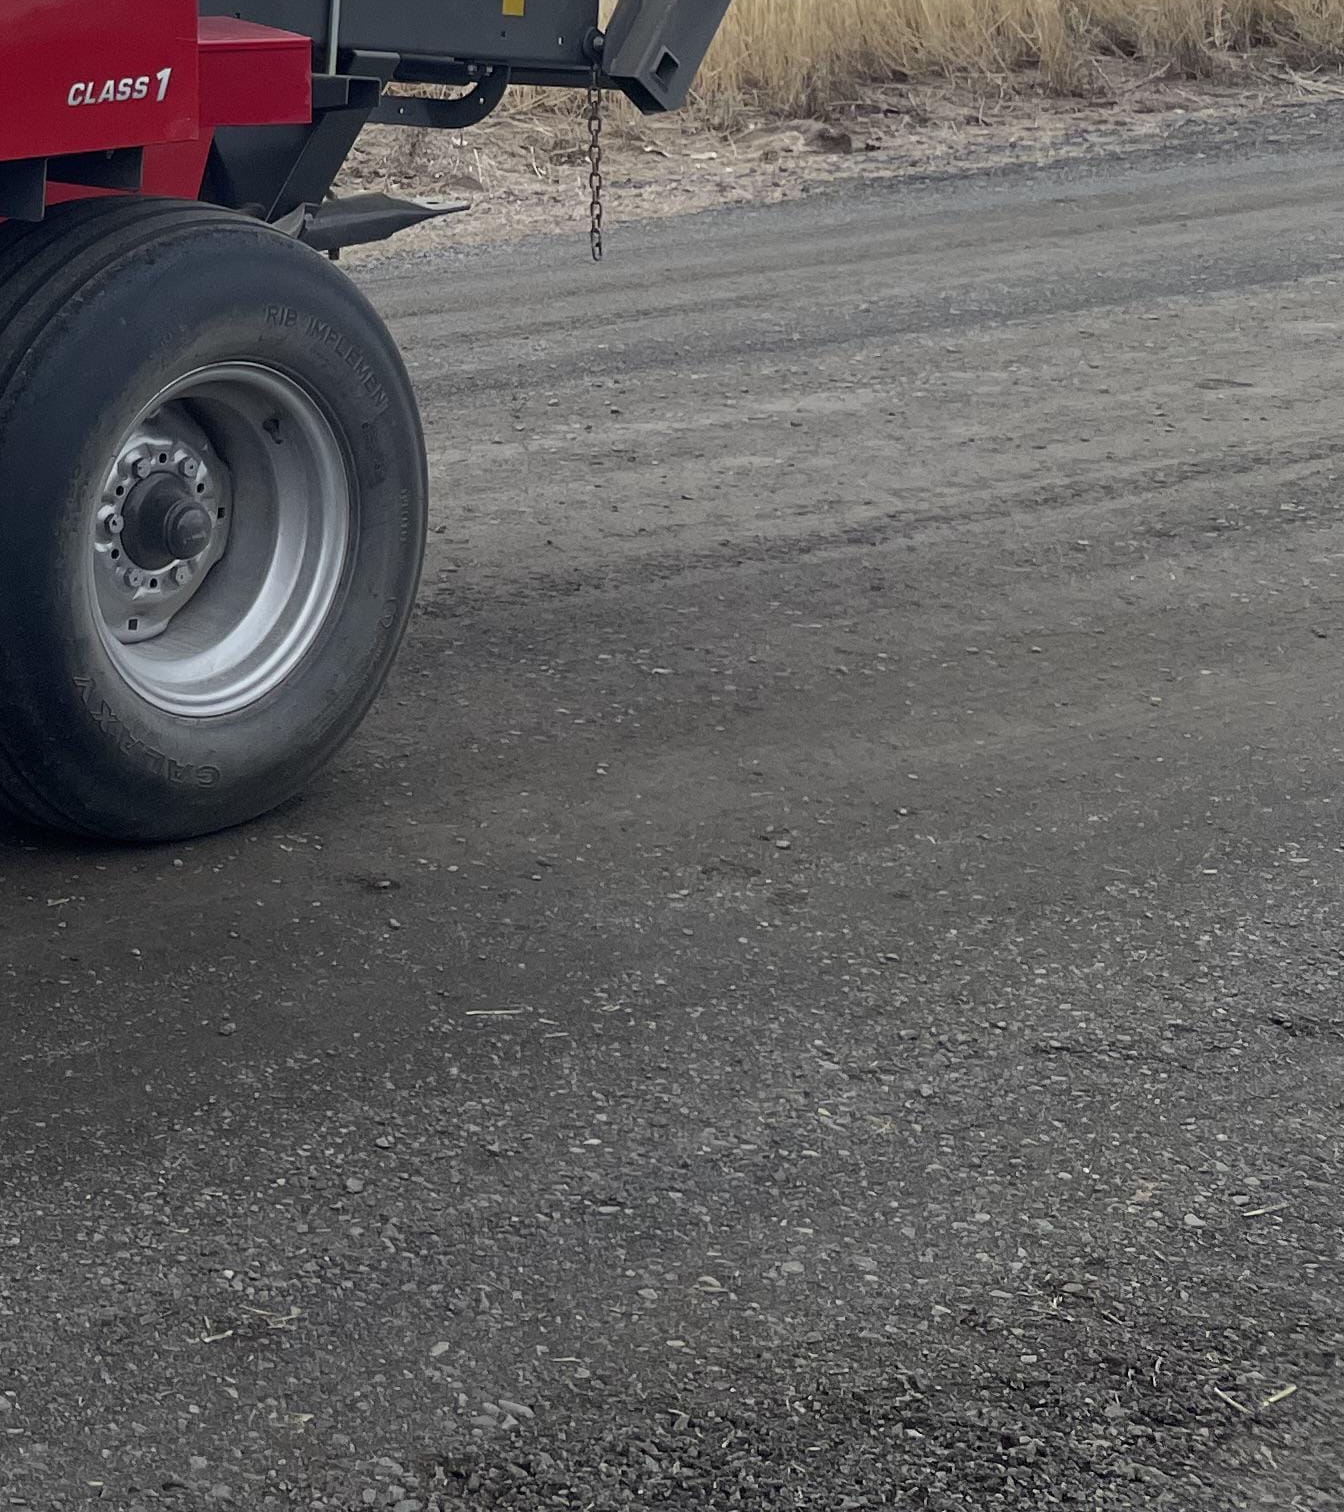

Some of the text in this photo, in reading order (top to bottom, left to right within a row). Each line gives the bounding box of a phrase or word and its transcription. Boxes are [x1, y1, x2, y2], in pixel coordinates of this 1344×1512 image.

[67, 67, 173, 106] CLASS 1
[265, 303, 298, 328] RIB
